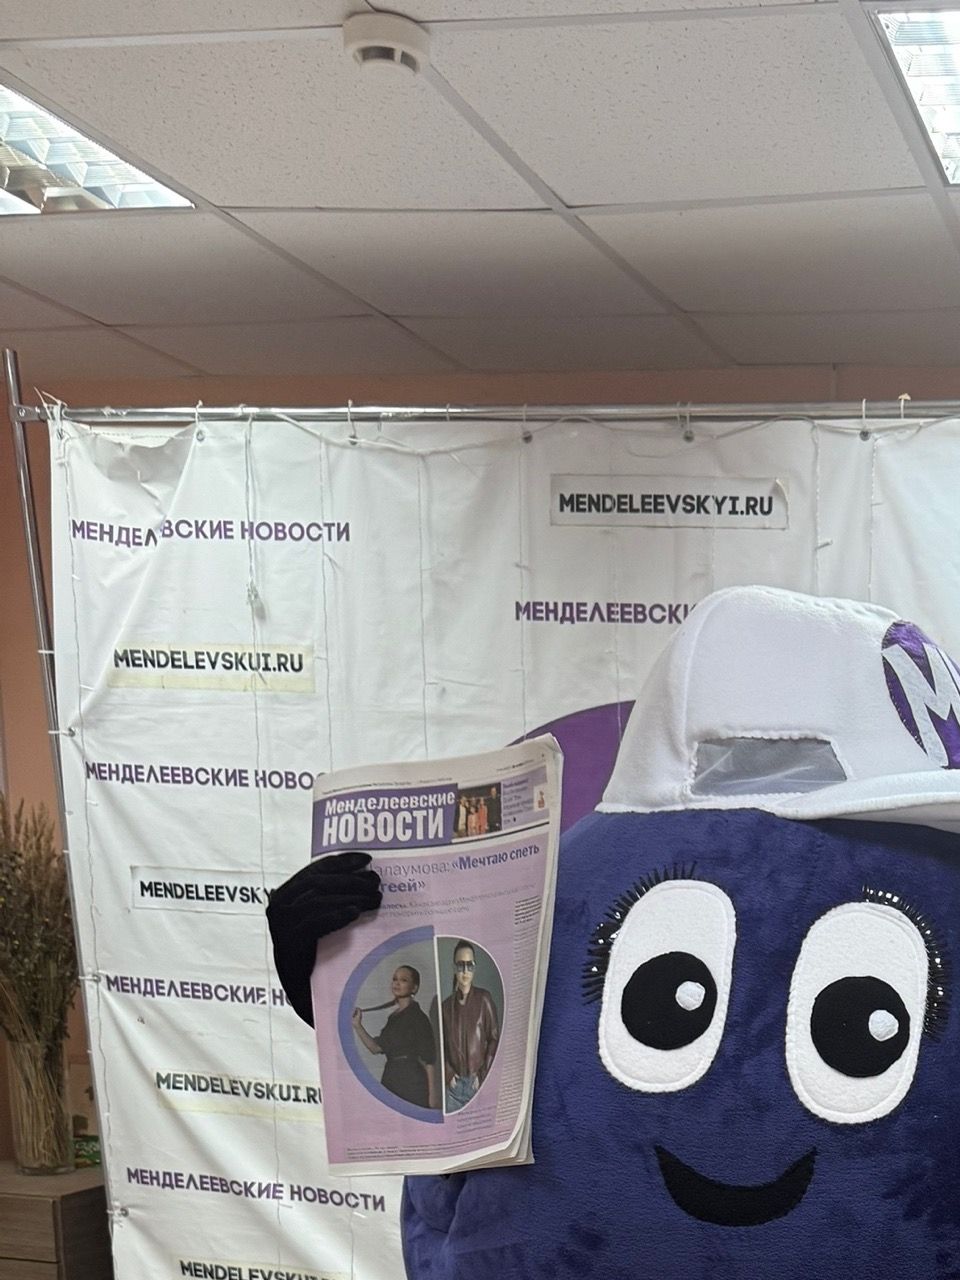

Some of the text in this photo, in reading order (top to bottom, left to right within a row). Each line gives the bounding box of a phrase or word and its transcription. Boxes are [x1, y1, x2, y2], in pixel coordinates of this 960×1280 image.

[559, 493, 774, 516] MENDELEEVSKYI.RU
[241, 520, 351, 542] НОВОСТИ
[113, 648, 304, 672] MENDELEVSKUI.RU
[85, 761, 250, 788] МЕНДЕЛЕЕВСКИЕ
[324, 791, 456, 817] Менделеевские
[322, 807, 444, 847] НОВОСТИ
[509, 845, 540, 860] спеть
[140, 880, 276, 904] MENDELEEVSKY
[105, 974, 267, 1005] МЕНДЕЛЕЕВСКИЕ
[126, 1167, 386, 1213] МЕНДЕЛЕЕВСКИЕ НОВОСТИ
